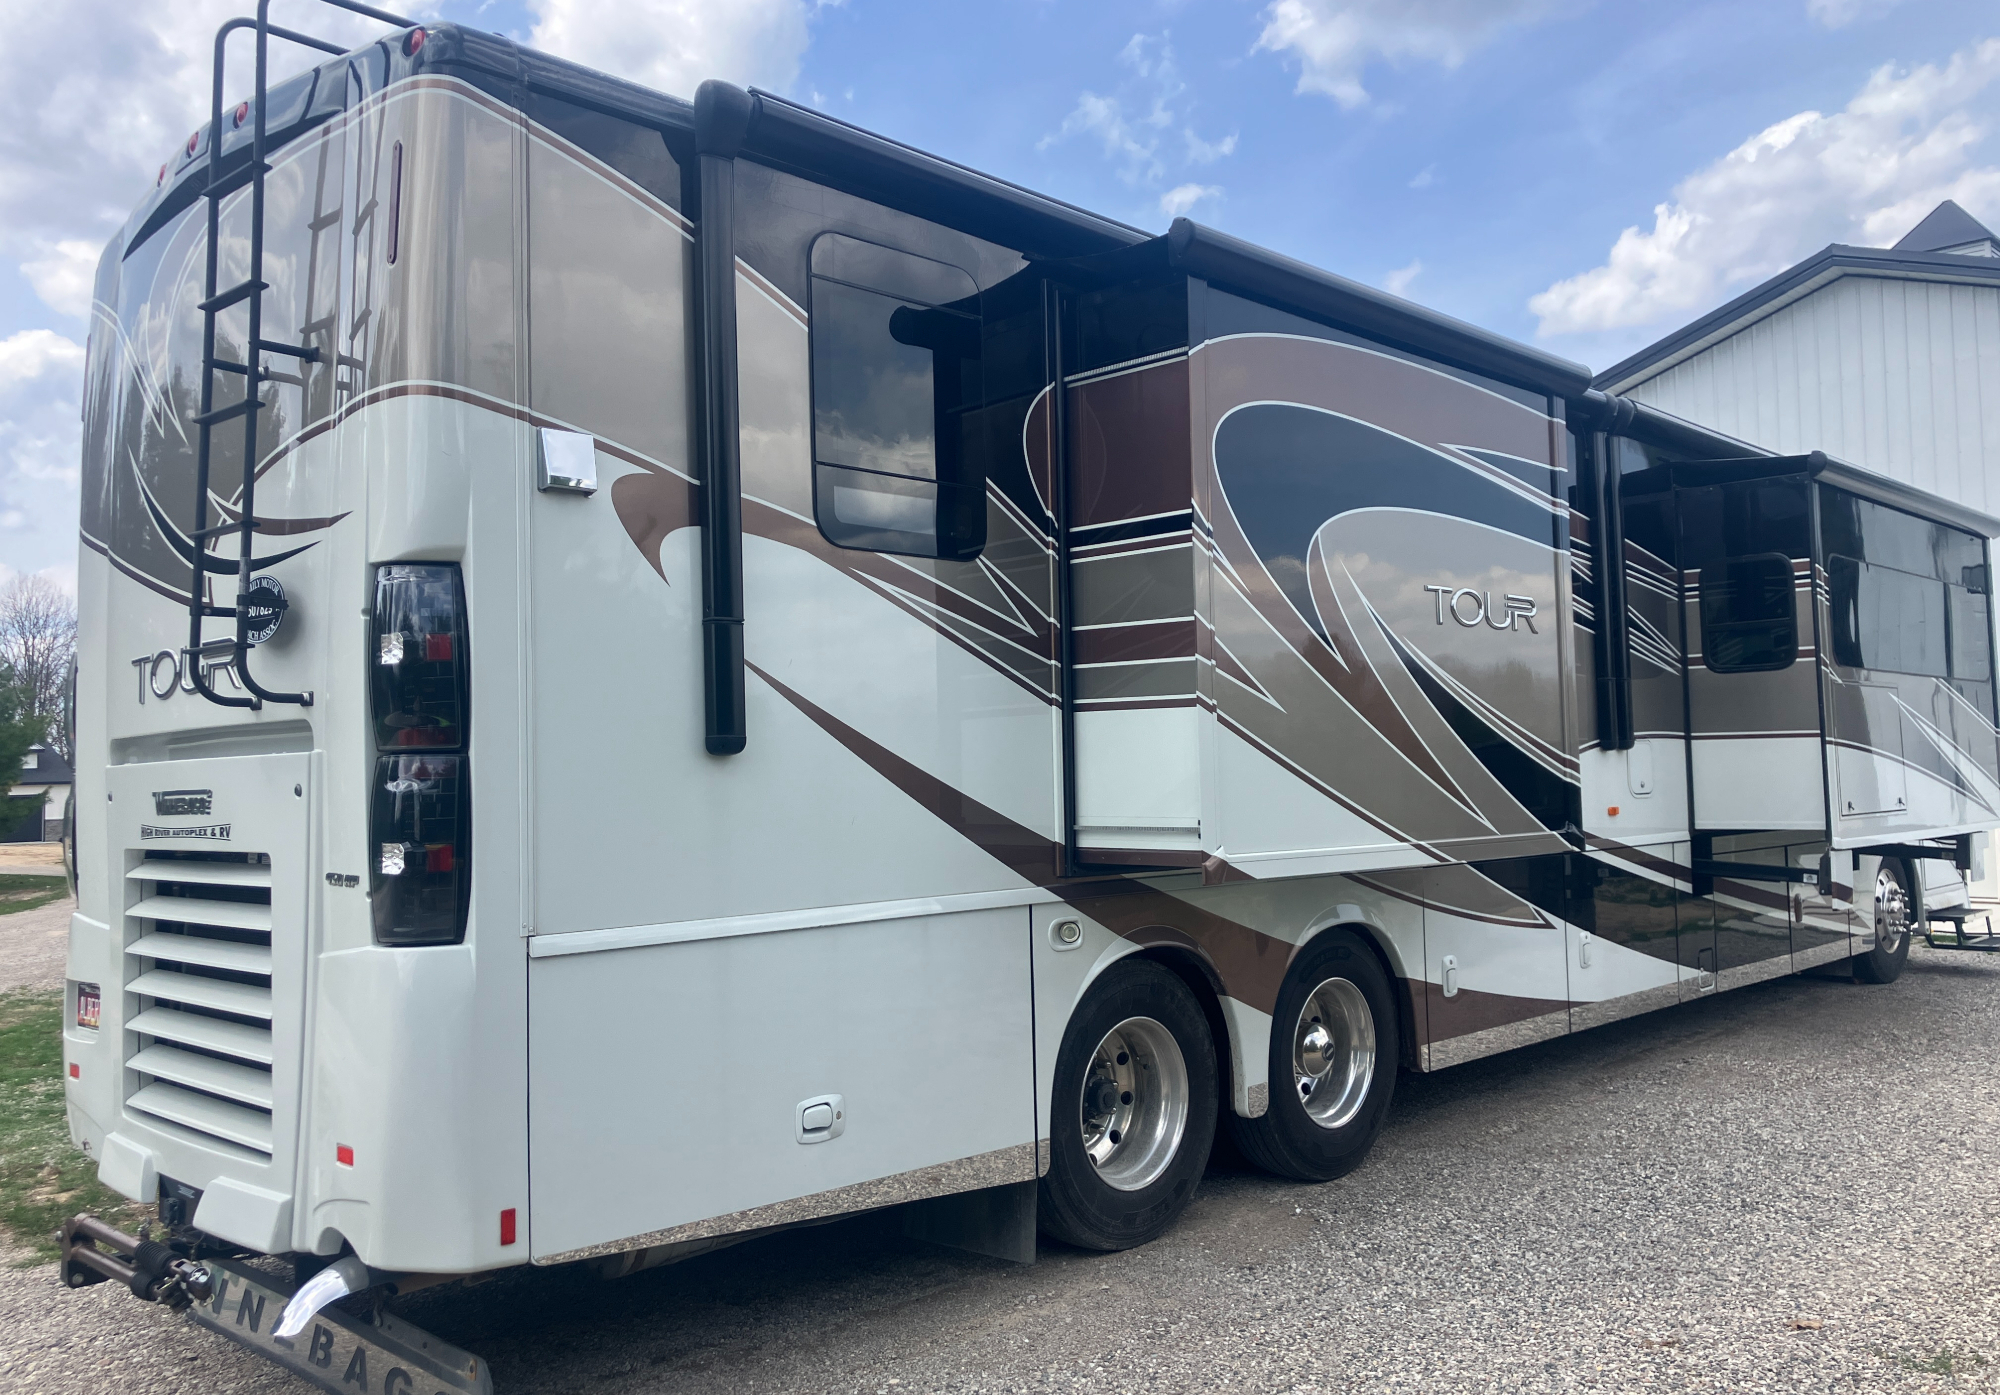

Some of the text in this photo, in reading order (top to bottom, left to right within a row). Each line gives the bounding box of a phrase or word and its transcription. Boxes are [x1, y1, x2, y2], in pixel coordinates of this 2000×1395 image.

[261, 578, 280, 596] MOTOR
[1424, 585, 1539, 634] TOUR
[131, 636, 242, 705] TOUR
[155, 828, 171, 837] RIVER
[172, 828, 208, 837] AUTOPLEX
[210, 827, 217, 838] &
[219, 825, 231, 839] RV
